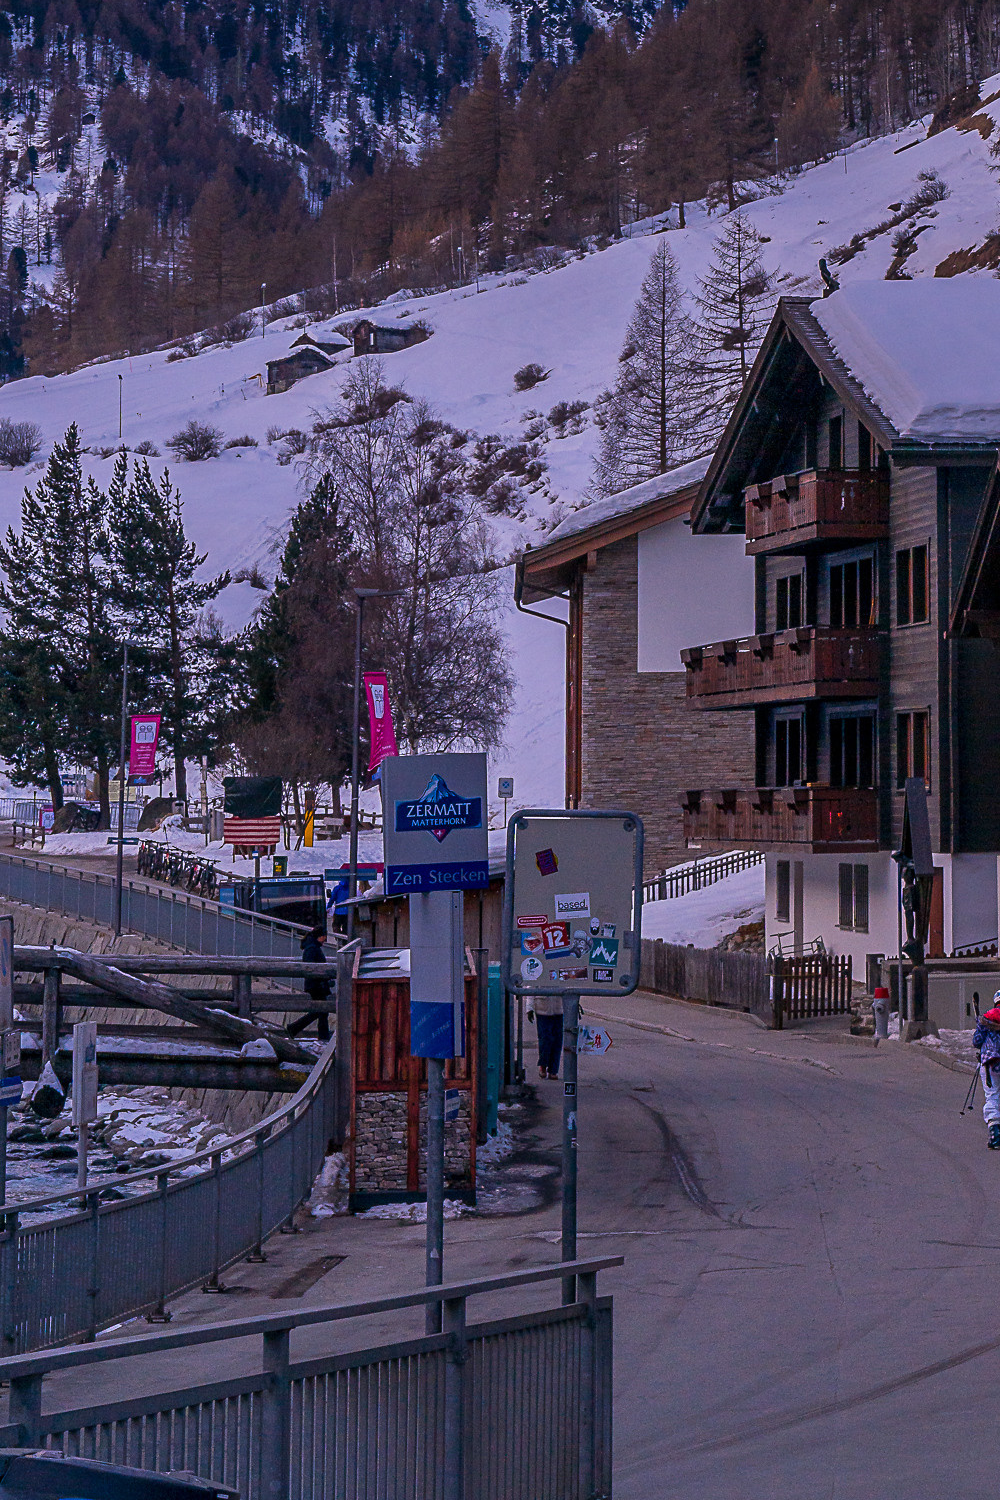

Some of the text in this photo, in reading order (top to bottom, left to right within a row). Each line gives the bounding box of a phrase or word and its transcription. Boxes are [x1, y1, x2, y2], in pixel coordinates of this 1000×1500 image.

[406, 802, 472, 818] ZERMATT
[411, 817, 467, 827] MATTERHORN
[392, 868, 486, 886] Zen Stecken
[545, 930, 565, 948] 12
